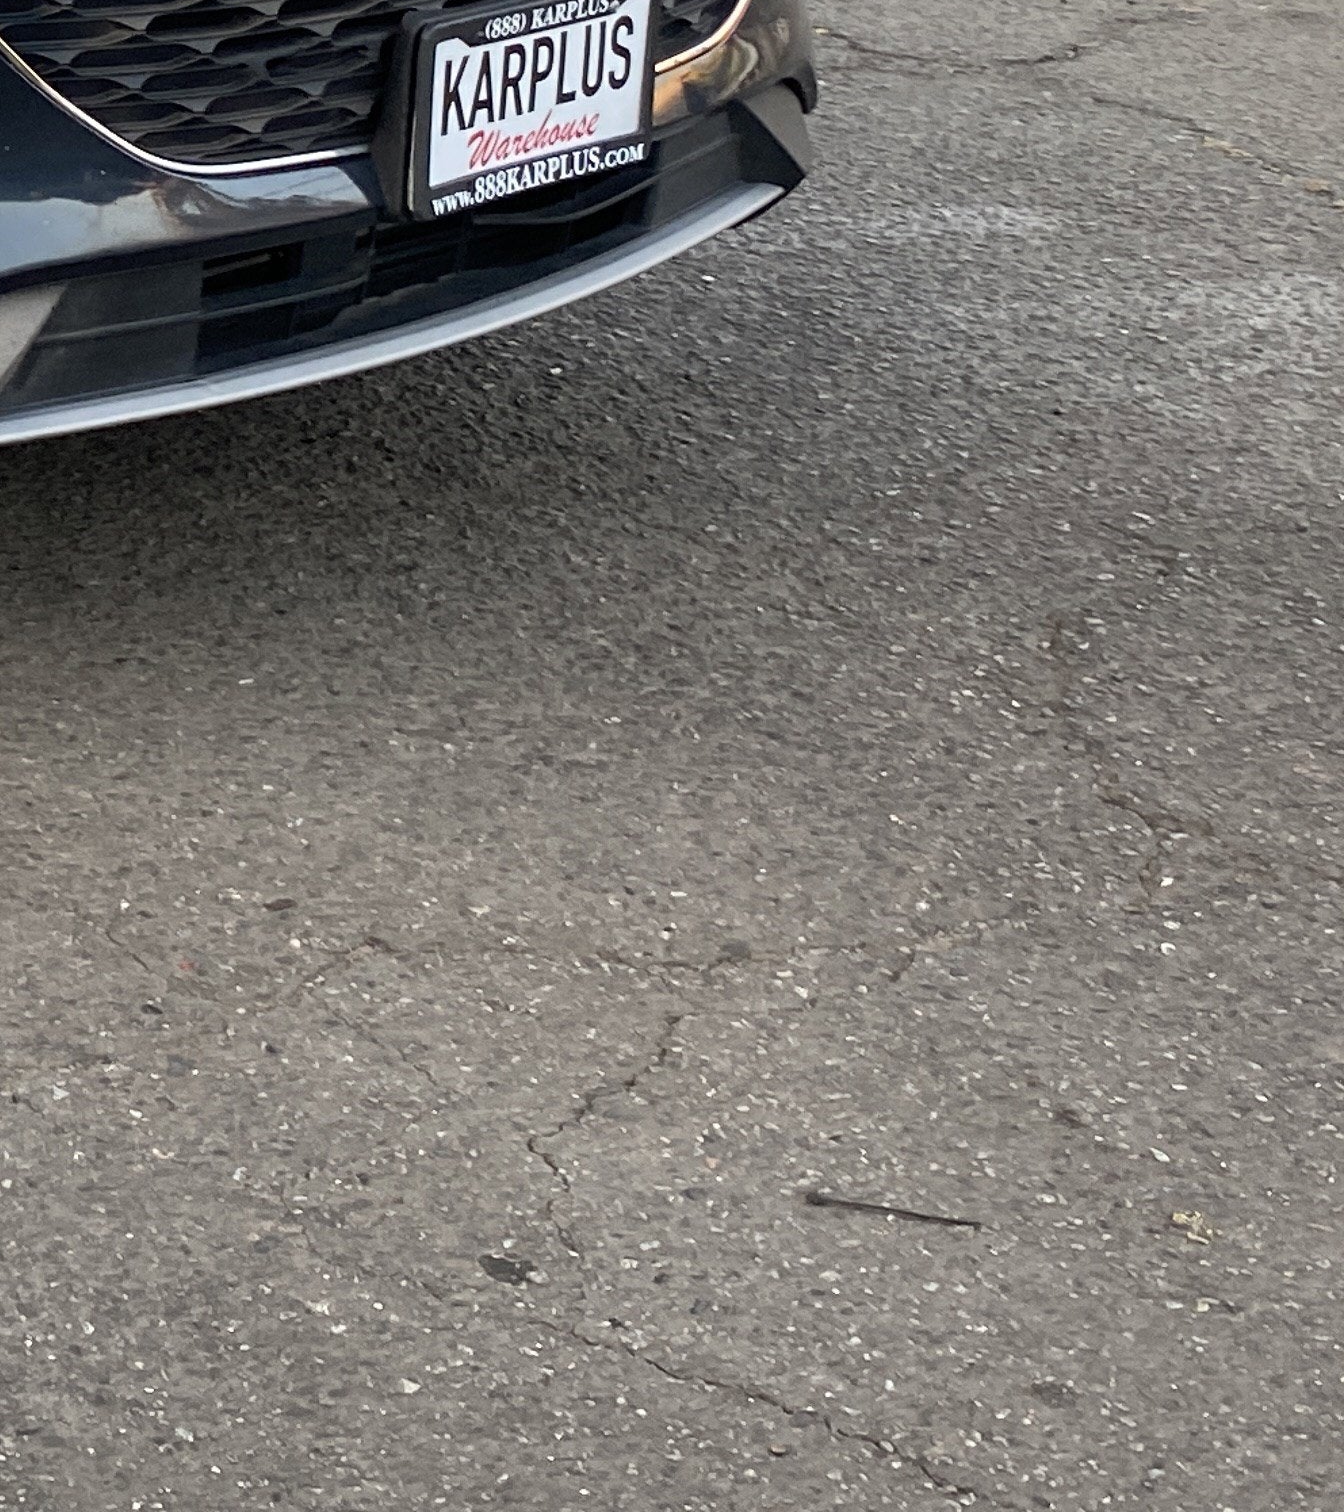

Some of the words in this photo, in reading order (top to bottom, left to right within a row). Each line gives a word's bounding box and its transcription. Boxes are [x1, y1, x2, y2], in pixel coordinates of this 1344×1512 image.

[484, 12, 527, 41] (888)
[440, 15, 634, 136] KARPLUS
[466, 108, 601, 171] Warehouse
